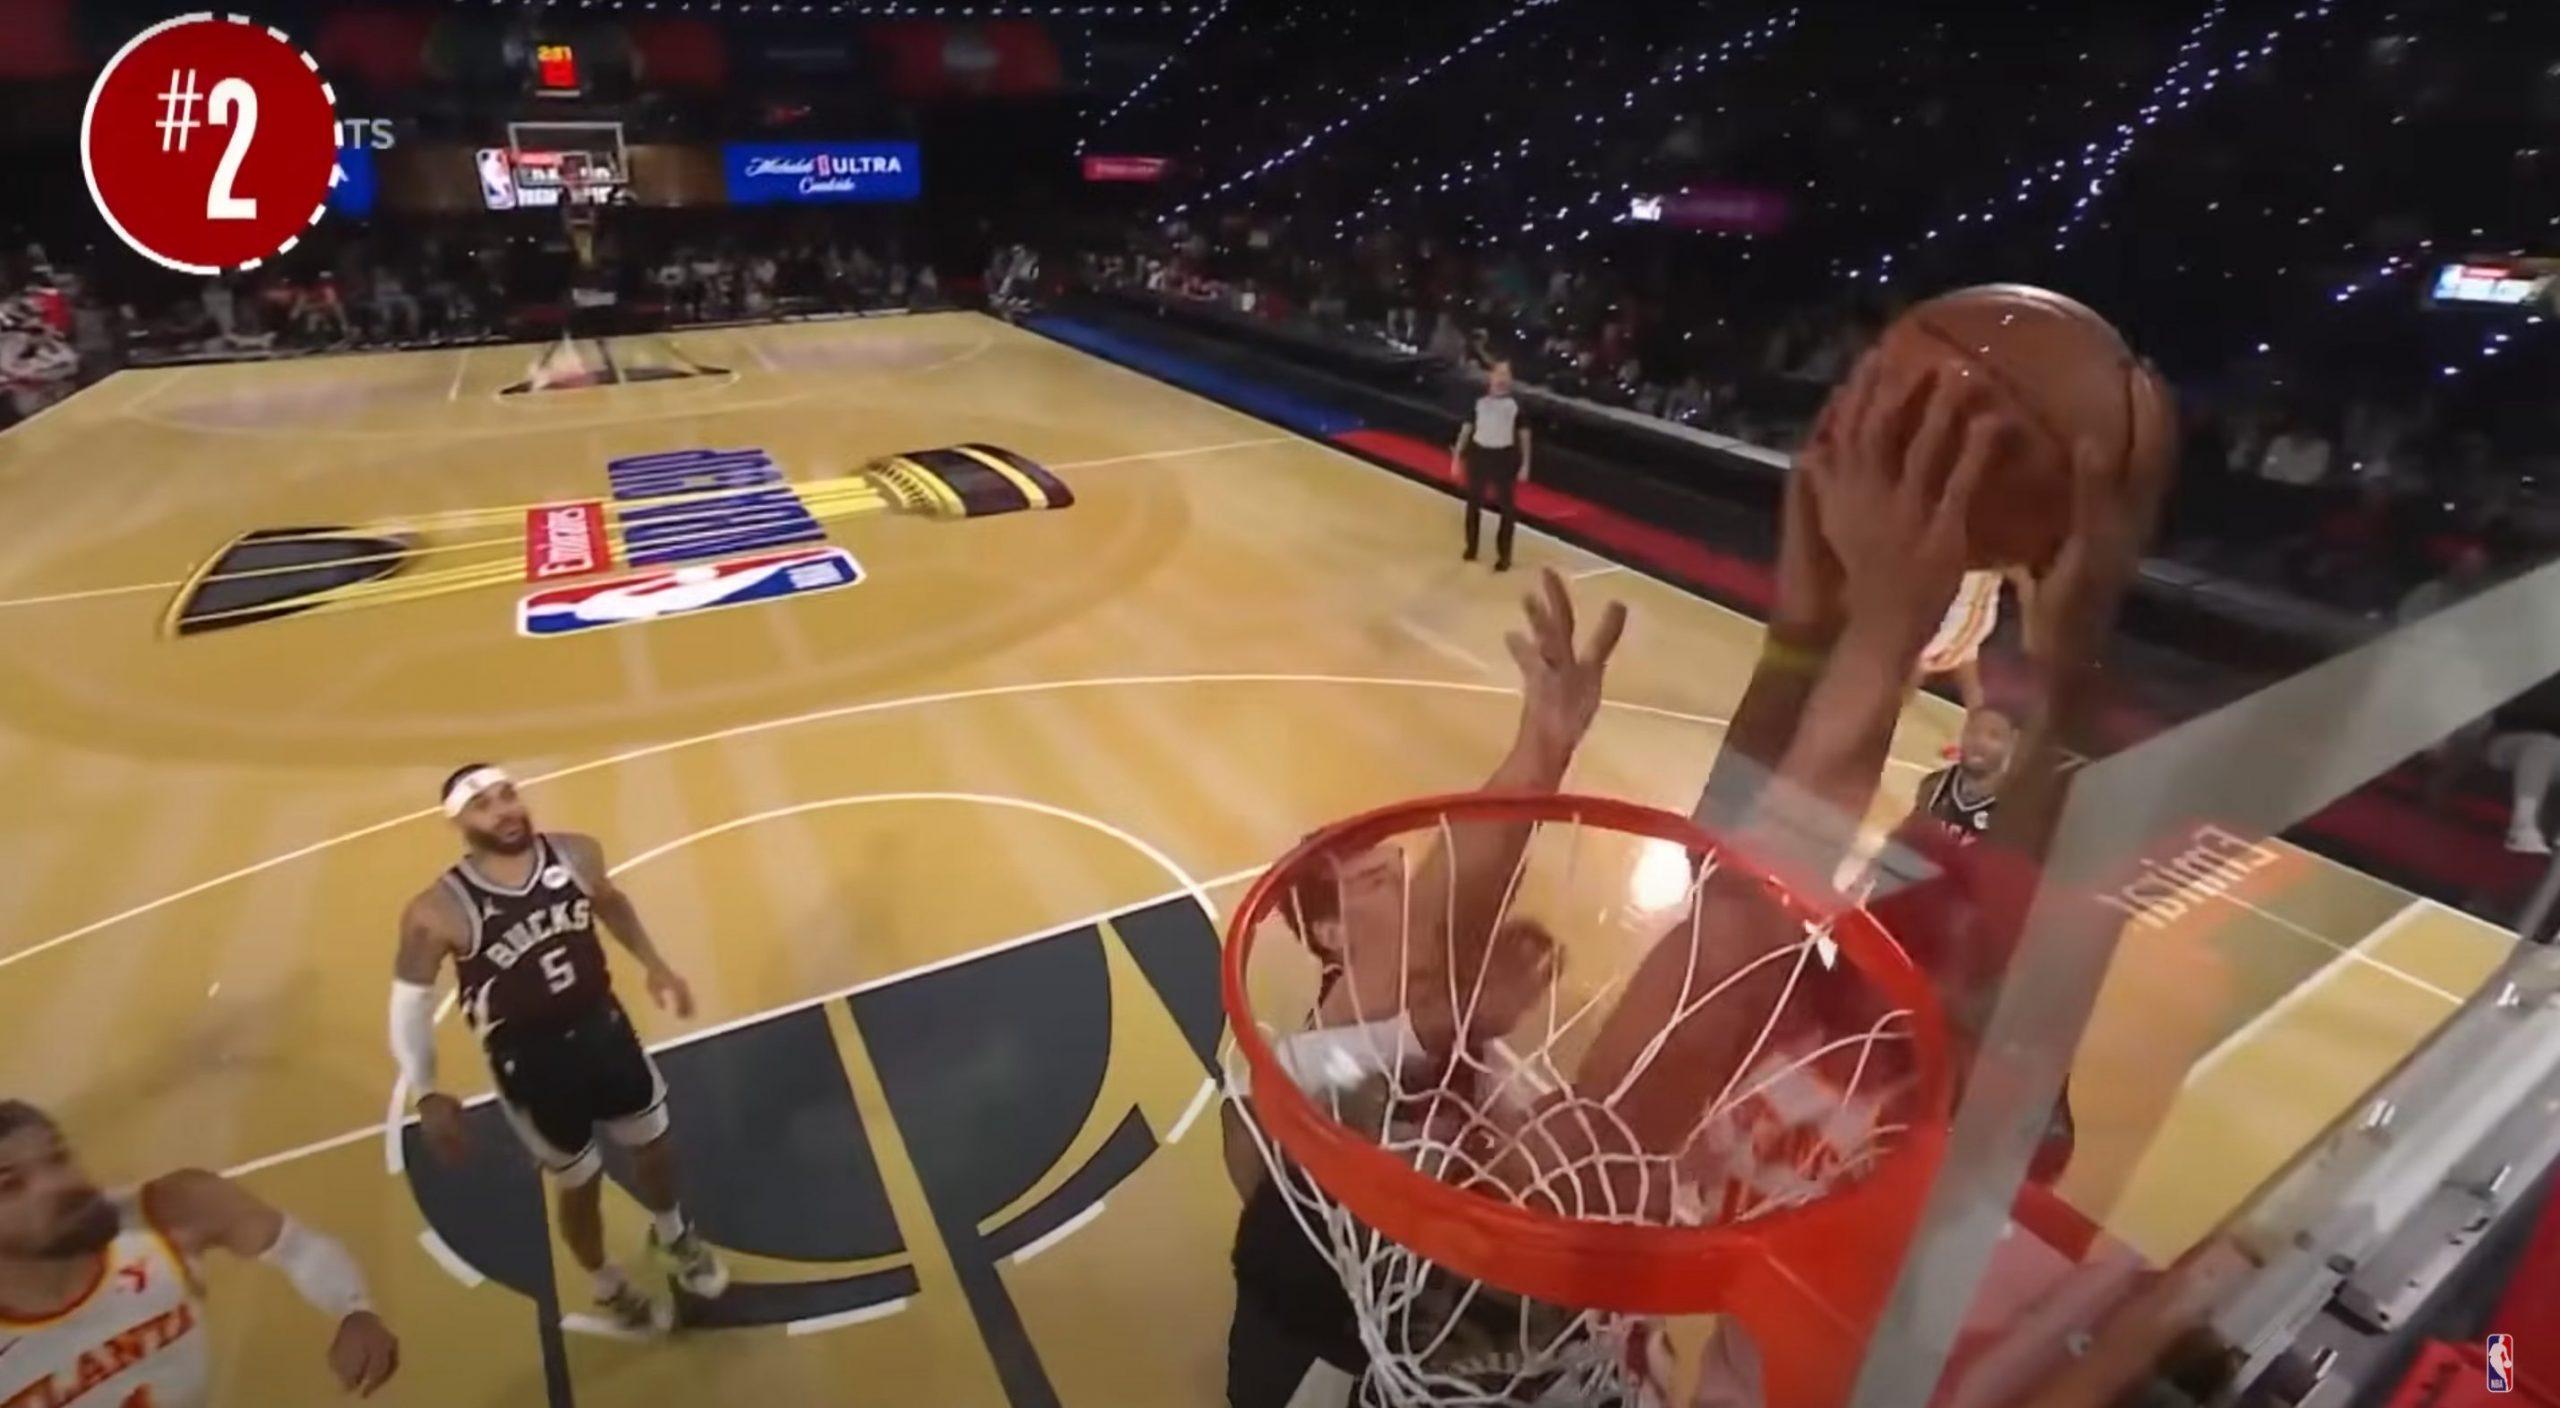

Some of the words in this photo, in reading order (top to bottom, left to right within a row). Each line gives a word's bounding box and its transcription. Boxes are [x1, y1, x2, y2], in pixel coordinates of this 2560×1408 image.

[832, 156, 902, 174] ULTRA
[485, 899, 590, 970] BUCKS
[538, 946, 577, 994] 5
[0, 1303, 195, 1408] TLANTA
